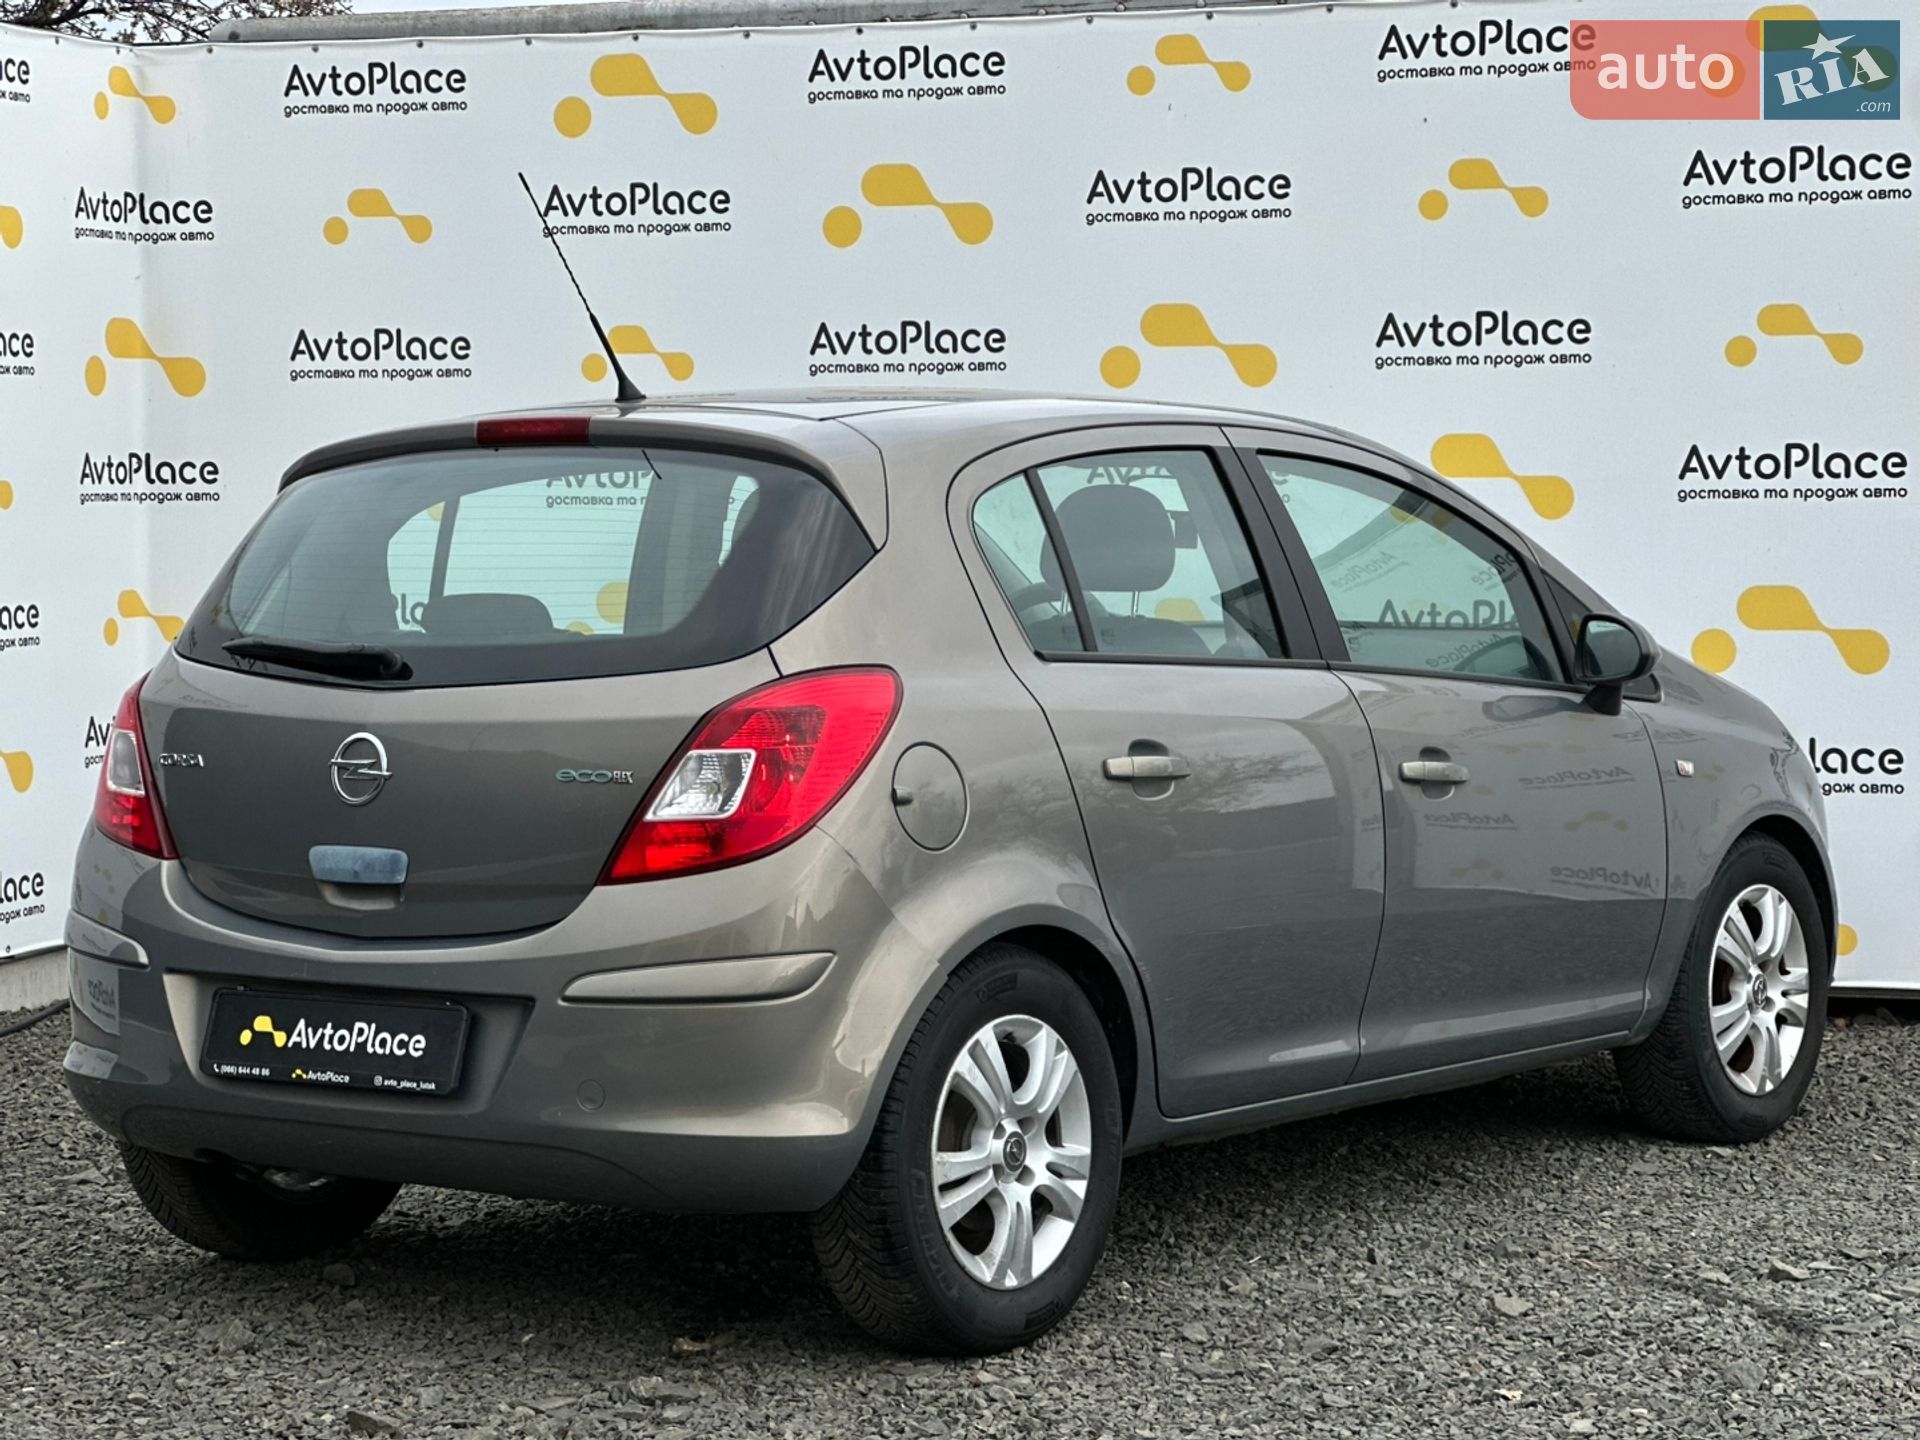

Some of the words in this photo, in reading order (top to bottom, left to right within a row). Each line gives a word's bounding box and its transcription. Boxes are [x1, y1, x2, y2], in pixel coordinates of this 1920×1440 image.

[1378, 19, 1596, 60] AvtoPlace
[808, 45, 1005, 83] AvtoPlace
[1378, 67, 1455, 82] доставка
[1460, 66, 1482, 76] та
[1488, 63, 1549, 77] продаж
[1554, 60, 1597, 71] авто
[284, 62, 466, 97] AvtoPlace
[808, 90, 878, 104] доставка
[883, 89, 903, 99] та
[908, 87, 963, 100] продаж
[967, 85, 1006, 95] авто
[284, 104, 349, 118] доставка
[354, 104, 372, 113] та
[377, 102, 427, 115] продаж
[432, 101, 467, 111] авто
[1682, 145, 1911, 186] AvtoPlace
[1087, 167, 1291, 204] AvtoPlace
[75, 187, 212, 224] AvtoPlace
[543, 182, 730, 217] AvtoPlace
[1682, 194, 1763, 209] доставка
[1769, 193, 1793, 203] та
[1798, 190, 1862, 204] продаж
[1867, 189, 1912, 199] авто
[1086, 212, 1159, 225] доставка
[1164, 211, 1185, 221] та
[1190, 210, 1247, 223] продаж
[1252, 208, 1291, 218] авто
[75, 228, 113, 240] доставка
[128, 232, 177, 244] продаж
[180, 232, 214, 241] авто
[543, 225, 610, 238] доставка
[614, 224, 635, 234] та
[638, 223, 690, 235] продаж
[695, 222, 731, 232] авто
[810, 320, 1006, 355] AvtoPlace
[1376, 311, 1591, 347] AvtoPlace
[291, 328, 470, 361] AvtoPlace
[810, 363, 879, 376] доставка
[884, 363, 904, 373] та
[909, 362, 964, 374] продаж
[968, 361, 1006, 371] авто
[1375, 356, 1451, 369] доставка
[1457, 355, 1479, 366] та
[1484, 354, 1544, 367] продаж
[1550, 354, 1591, 364] авто
[290, 369, 354, 382] доставка
[359, 369, 378, 378] та
[382, 368, 432, 380] продаж
[437, 368, 471, 378] авто
[80, 453, 219, 484] AvtoPlace
[1679, 443, 1907, 480] AvtoPlace
[80, 493, 118, 505] доставка
[134, 492, 182, 505] продаж
[186, 492, 219, 501] авто
[1678, 489, 1759, 502] доставка
[1764, 489, 1788, 499] та
[1794, 488, 1858, 501] продаж
[1863, 487, 1907, 498] авто
[1859, 783, 1904, 794] авто
[287, 1018, 426, 1058] AvtoPlace
[307, 1070, 350, 1083] AvtoPlace
